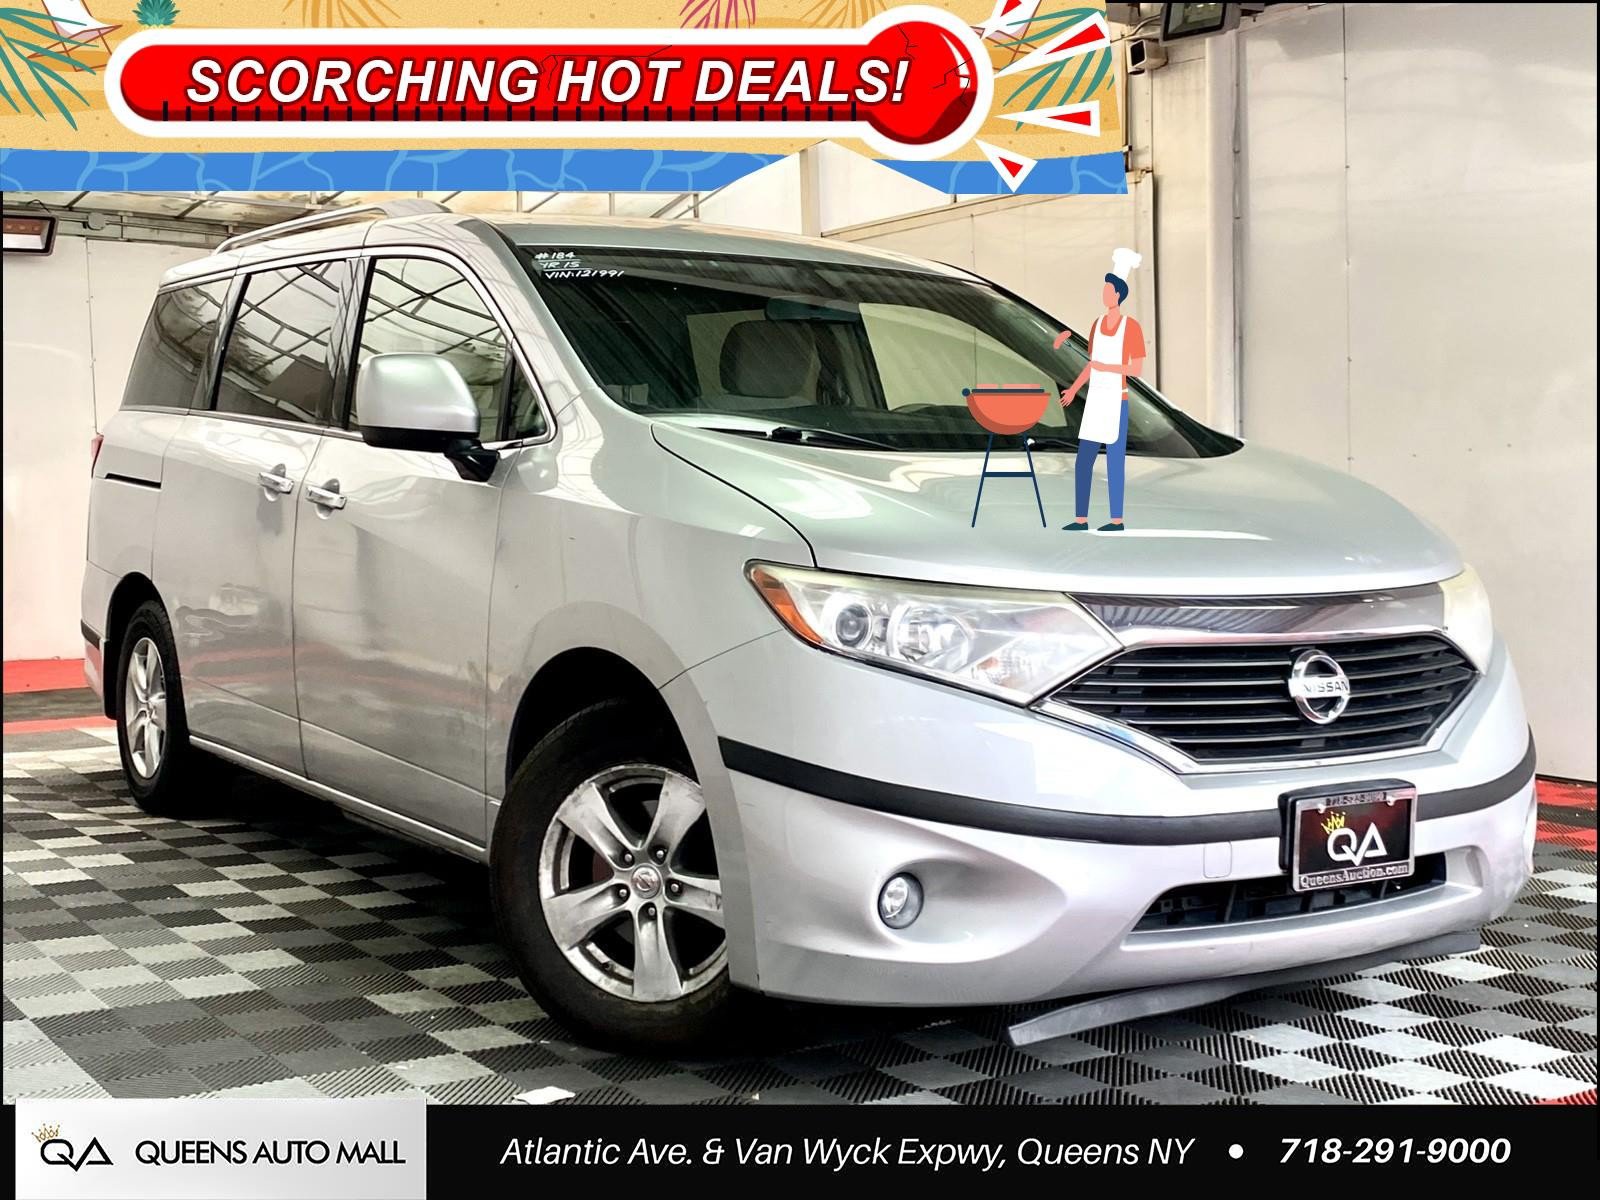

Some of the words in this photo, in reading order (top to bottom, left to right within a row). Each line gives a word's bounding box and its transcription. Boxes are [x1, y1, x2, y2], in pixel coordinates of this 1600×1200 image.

[1303, 681, 1349, 694] NSSAN
[1327, 821, 1388, 867] QA
[1300, 863, 1409, 889] QueensAuction.com
